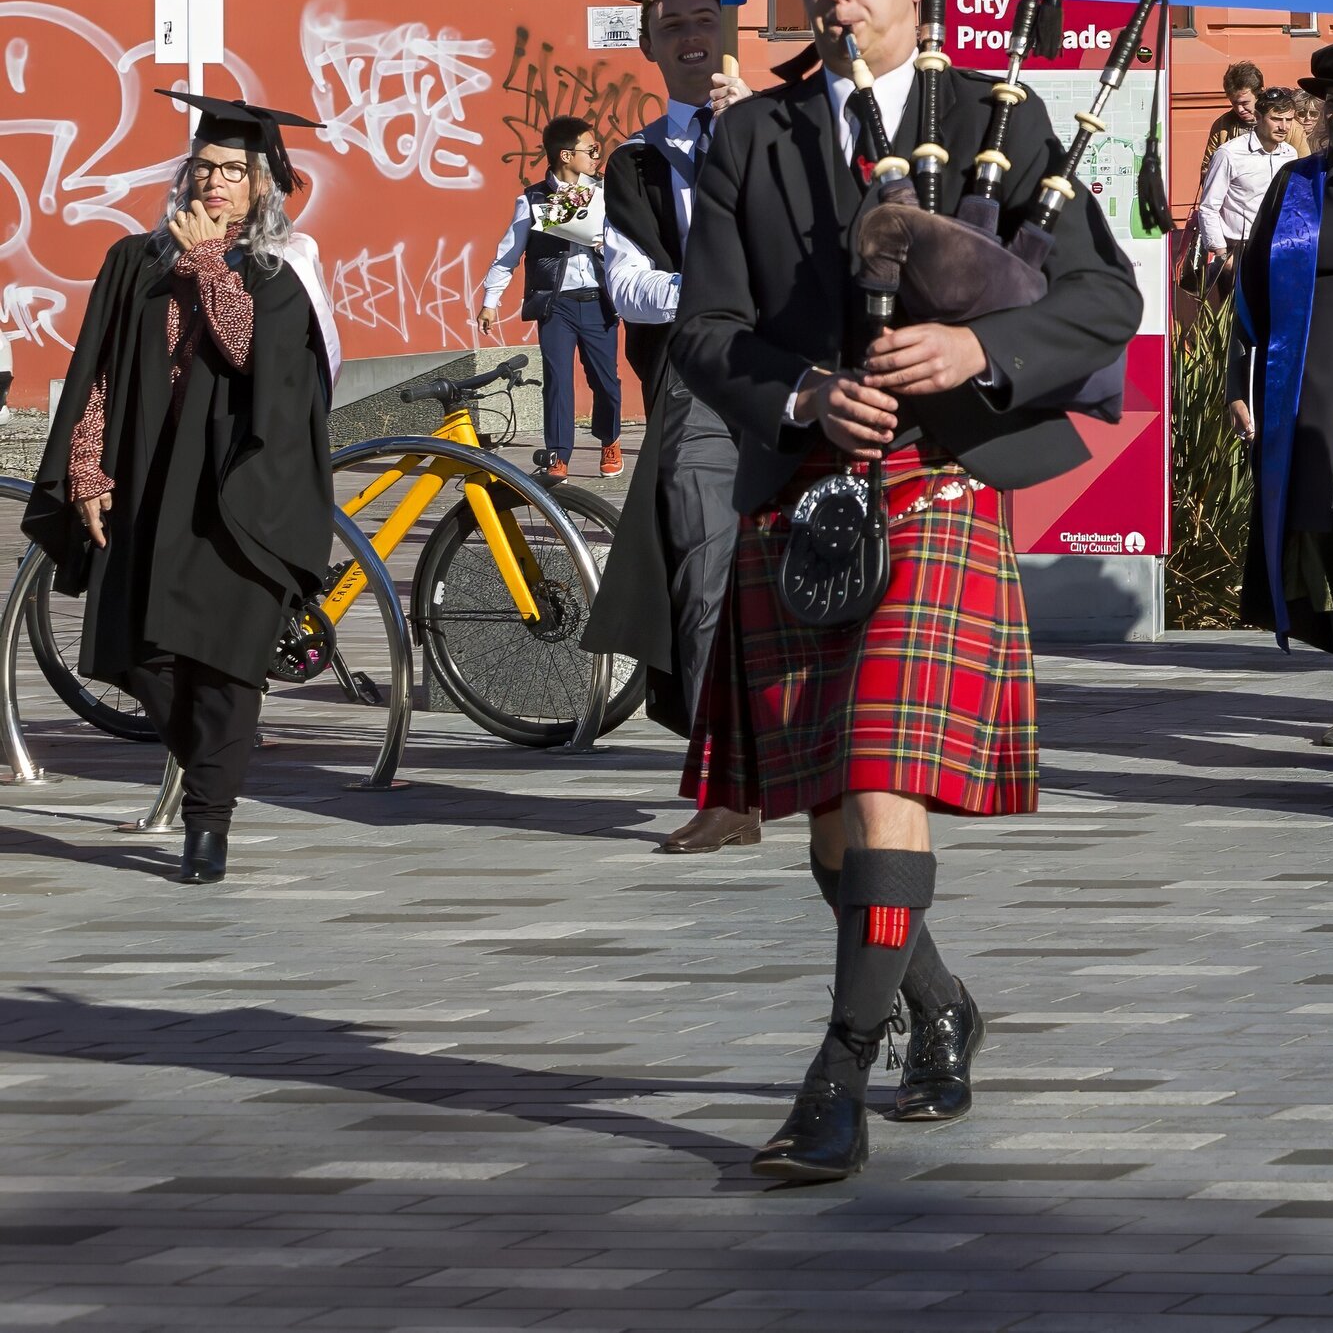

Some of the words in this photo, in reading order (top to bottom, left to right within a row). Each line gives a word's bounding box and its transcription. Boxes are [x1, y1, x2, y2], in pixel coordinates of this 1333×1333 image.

[956, 24, 1112, 50] Proade
[1060, 532, 1123, 543] Christchurch
[1070, 542, 1088, 554] City
[1088, 542, 1123, 553] Council
